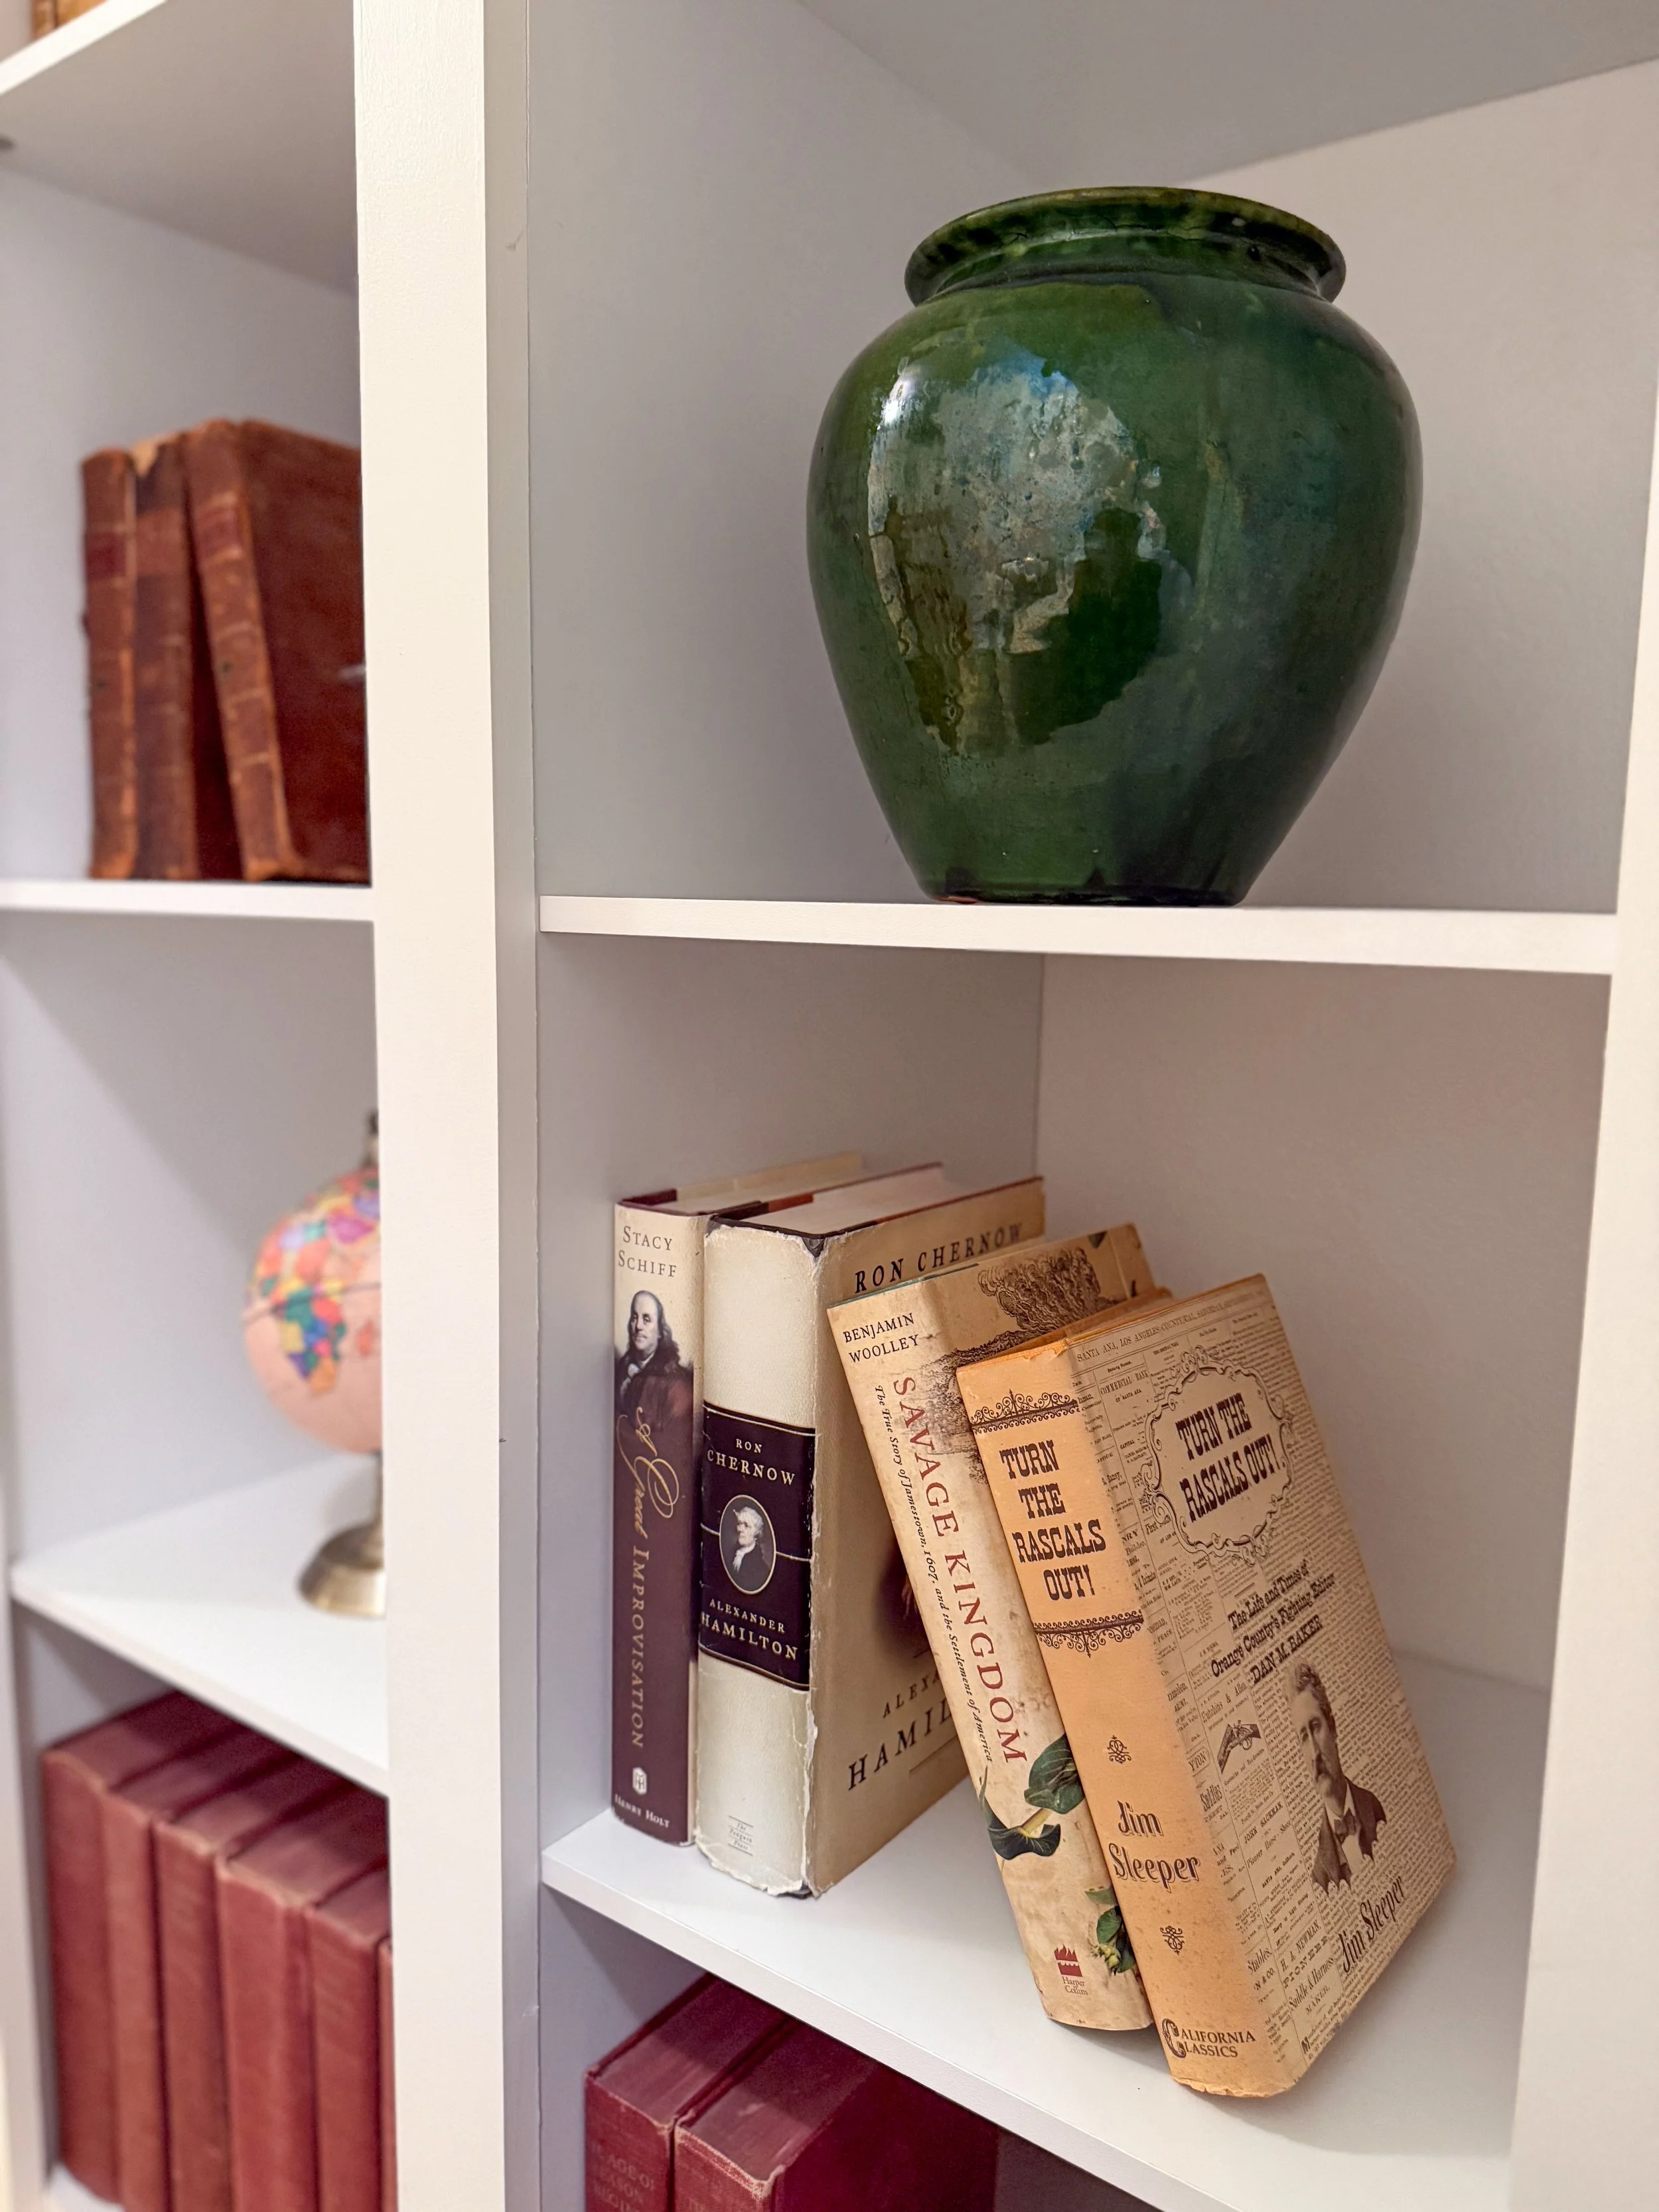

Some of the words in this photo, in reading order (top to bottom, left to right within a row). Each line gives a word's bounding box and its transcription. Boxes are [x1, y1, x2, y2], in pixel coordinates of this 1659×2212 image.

[622, 1226, 673, 1251] STACY
[618, 1250, 677, 1278] SCHIFF
[855, 1258, 904, 1293] RON
[918, 1222, 1023, 1272] CHERNOW
[843, 1313, 914, 1343] BENJAMIN
[1076, 1349, 1100, 1363] SANTA
[1120, 1336, 1132, 1348] LOS
[1135, 1327, 1160, 1343] ANGELES
[849, 1334, 918, 1363] WOOLLEY
[875, 1385, 885, 1406] The
[1100, 1377, 1132, 1395] COMMERCIAL
[1136, 1369, 1150, 1382] BANK
[881, 1408, 893, 1433] True
[1175, 1404, 1224, 1460] TURN
[1216, 1392, 1252, 1440] THE
[736, 1438, 762, 1453] RON
[889, 1436, 903, 1465] Story
[999, 1439, 1060, 1480] TURN
[616, 1414, 679, 1539] Great
[707, 1449, 796, 1486] CHERNOW
[897, 1469, 909, 1485] of
[1179, 1450, 1249, 1523] RASCALS
[1243, 1434, 1282, 1484] OUT!
[901, 1481, 926, 1549] Jamestown,
[1018, 1482, 1066, 1520] THE
[1011, 1518, 1106, 1564] RASCALS
[893, 1376, 959, 1537] SAVAGE
[944, 1550, 1027, 1763] KINGDOM
[923, 1551, 938, 1584] 1607,
[1043, 1564, 1096, 1601] OUT!
[709, 1598, 786, 1633] ALEXANDER
[936, 1587, 949, 1610] and
[1228, 1610, 1247, 1631] The
[1245, 1595, 1264, 1618] Life
[1264, 1581, 1281, 1606] and
[1277, 1570, 1301, 1593] Times
[700, 1611, 798, 1660] HAMILTON
[943, 1613, 952, 1631] the
[1211, 1645, 1244, 1677] Orange
[1243, 1615, 1281, 1653] County's
[1277, 1592, 1313, 1625] Fighting
[1310, 1573, 1335, 1599] Editor
[631, 1545, 649, 1748] IMPROVISATION
[949, 1634, 972, 1696] Settlement
[1250, 1651, 1277, 1684] DAN
[1275, 1643, 1290, 1664] M.
[1287, 1614, 1323, 1652] BAKER
[968, 1698, 975, 1714] of
[848, 1696, 952, 1791] HAMIL
[973, 1708, 993, 1763] America
[1117, 1799, 1164, 1838] Jim
[1244, 1826, 1258, 1844] JOHN
[1108, 1842, 1202, 1894] Sleeper
[1338, 1930, 1366, 1972] Jim
[1360, 1876, 1405, 1941] Sleeper
[1283, 1935, 1328, 1989] PIONEER
[1062, 1976, 1086, 1987] Harper
[1065, 1985, 1088, 1996] Collins
